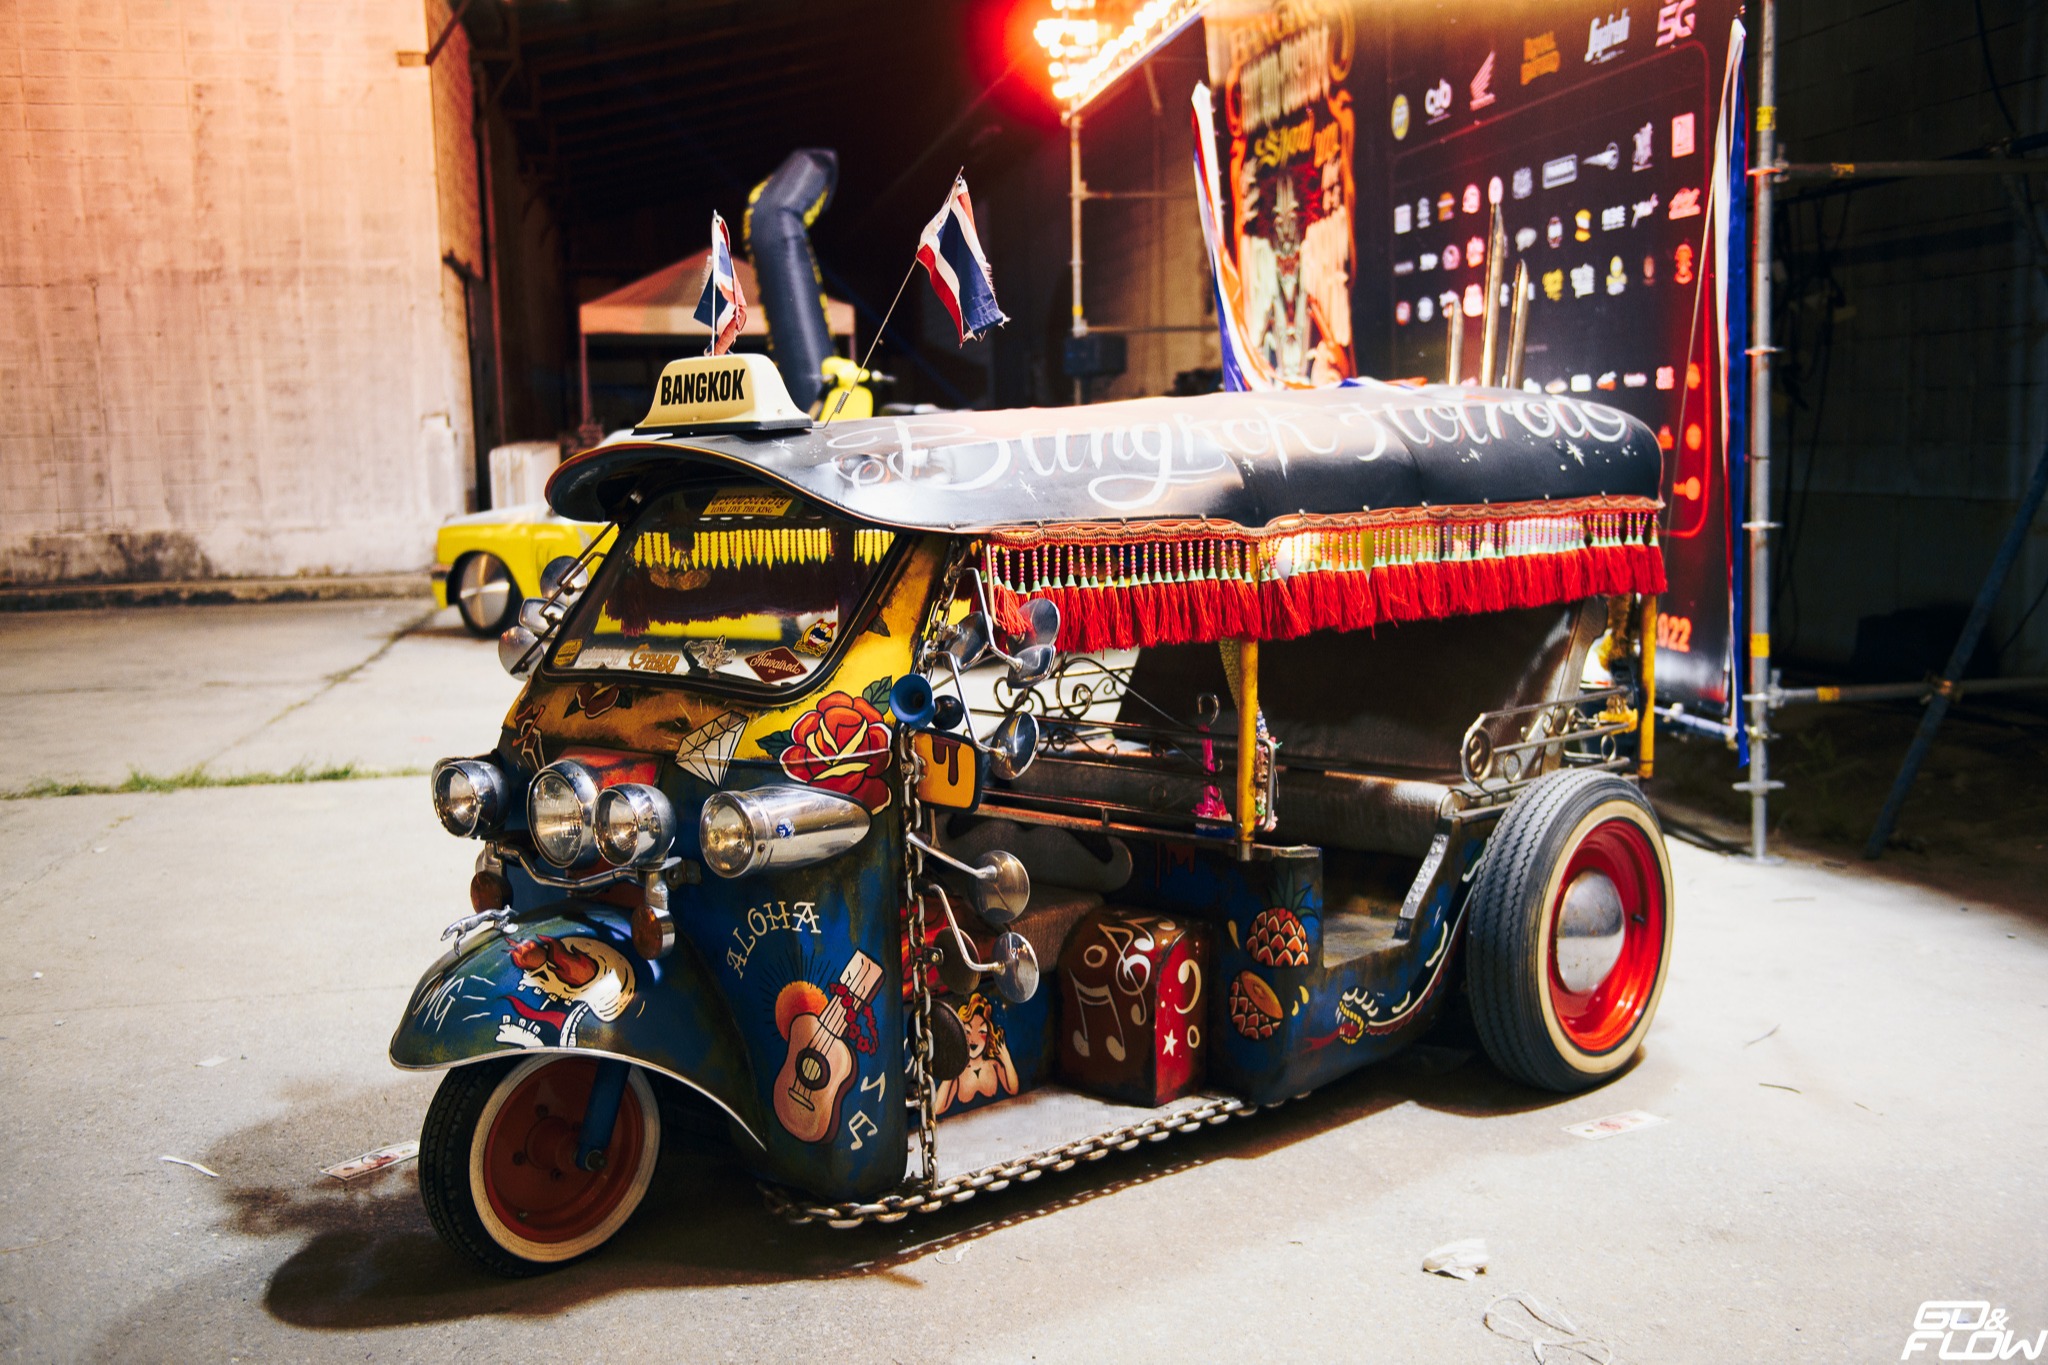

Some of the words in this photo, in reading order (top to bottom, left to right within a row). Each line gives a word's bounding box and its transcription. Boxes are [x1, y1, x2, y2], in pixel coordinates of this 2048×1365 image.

[661, 369, 745, 406] BANGKOK
[710, 505, 727, 513] LONG
[742, 505, 756, 513] THE
[756, 506, 774, 514] KING
[1656, 612, 1693, 653] 022
[726, 900, 822, 980] ALOHA
